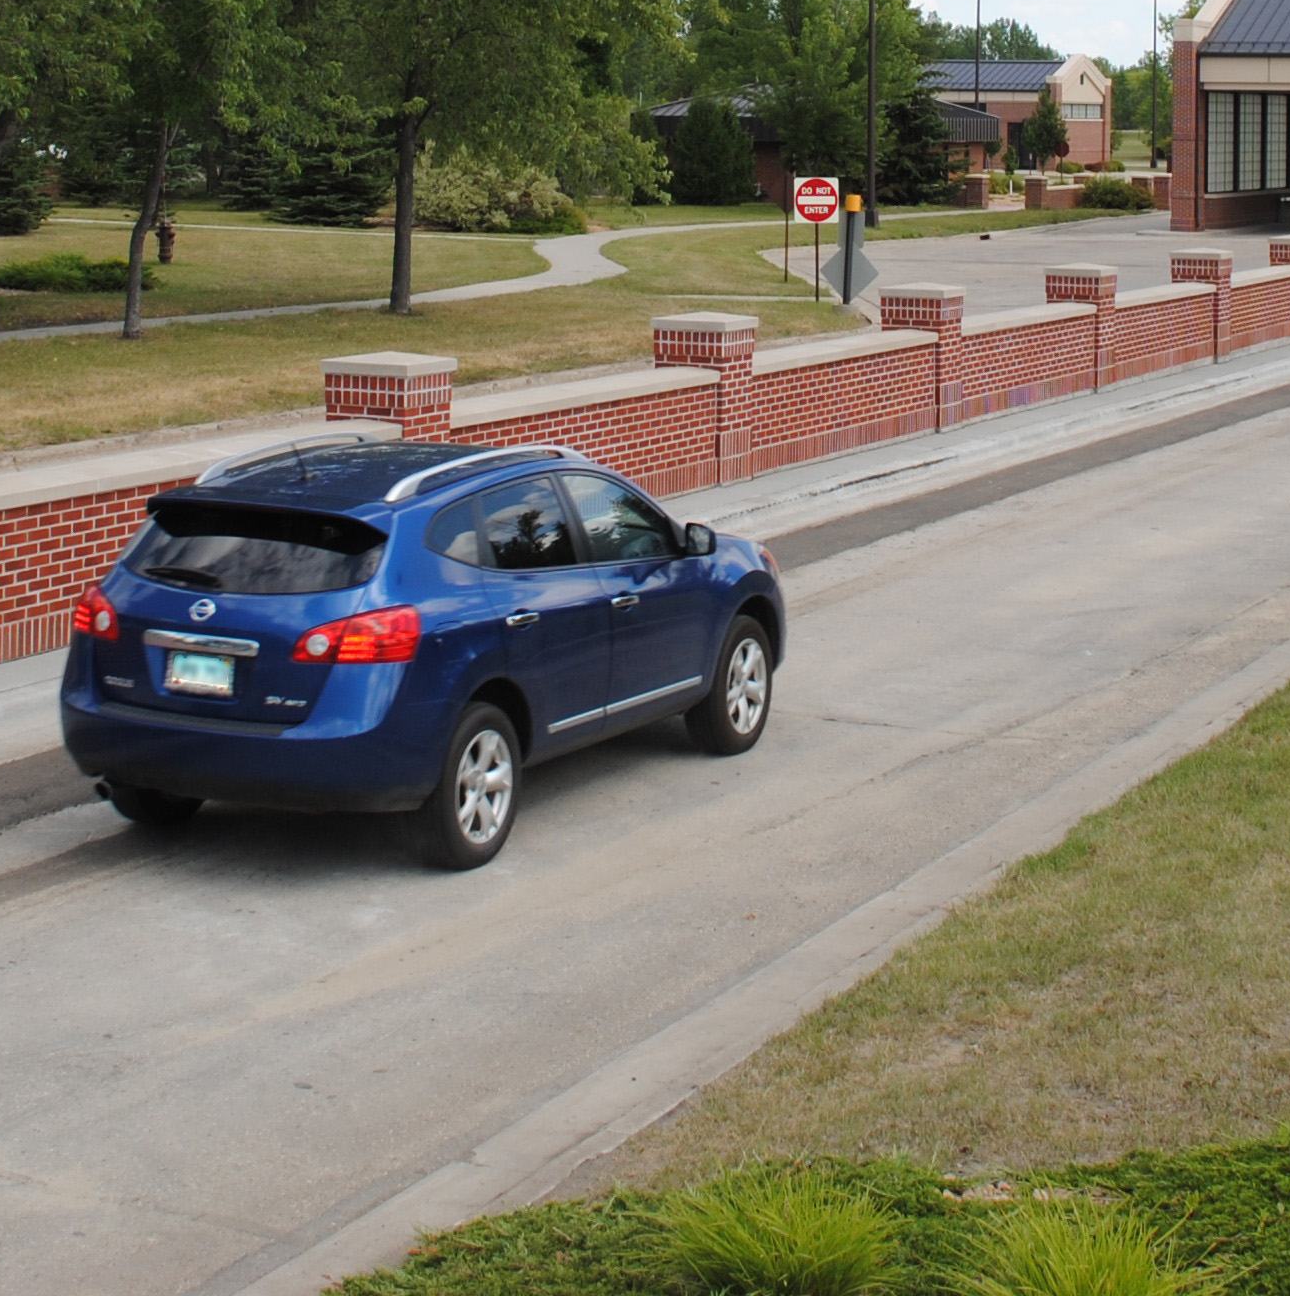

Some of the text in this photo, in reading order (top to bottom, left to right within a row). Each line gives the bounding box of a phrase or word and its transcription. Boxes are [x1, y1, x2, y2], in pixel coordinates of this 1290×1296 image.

[801, 186, 831, 195] DO NOT
[804, 206, 829, 214] ENTER
